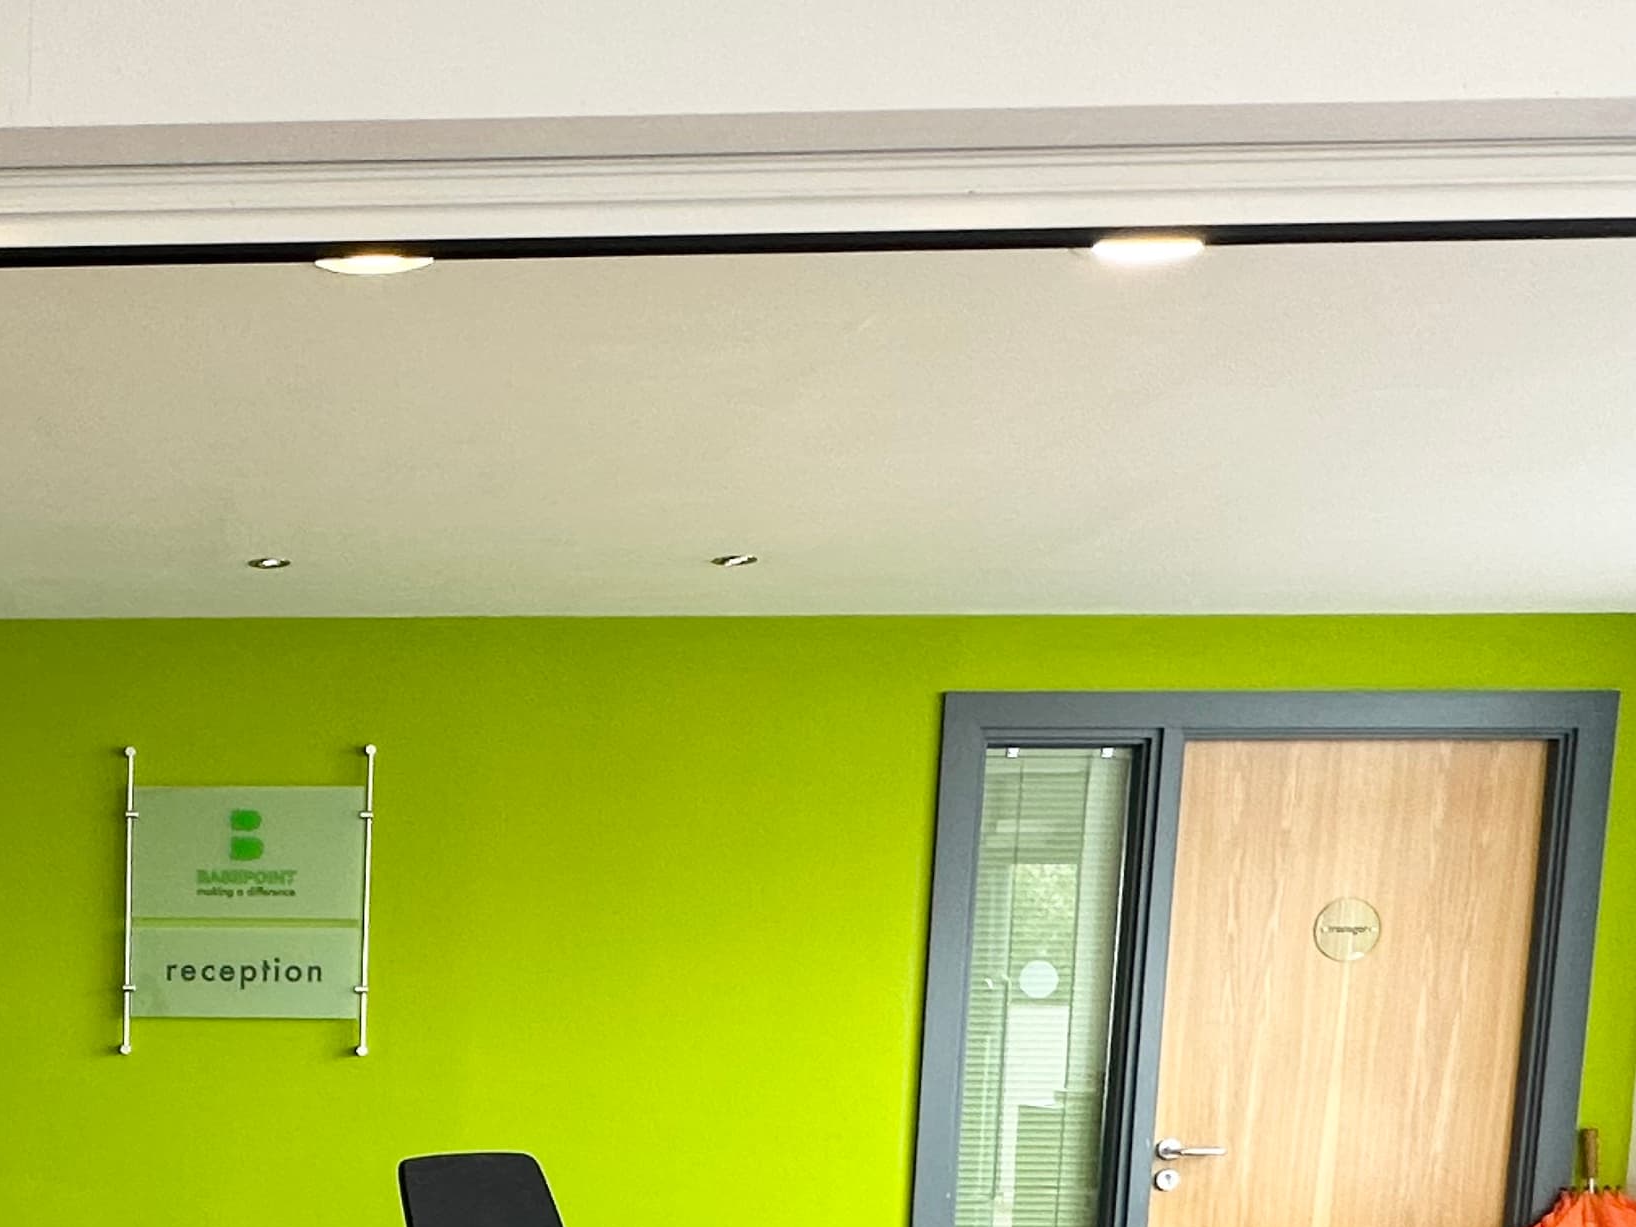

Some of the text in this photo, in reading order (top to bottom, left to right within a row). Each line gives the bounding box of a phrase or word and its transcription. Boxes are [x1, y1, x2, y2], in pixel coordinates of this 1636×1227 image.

[196, 869, 297, 885] BASEPOINT
[196, 886, 234, 898] making
[246, 886, 296, 897] difference
[166, 957, 323, 990] reception
